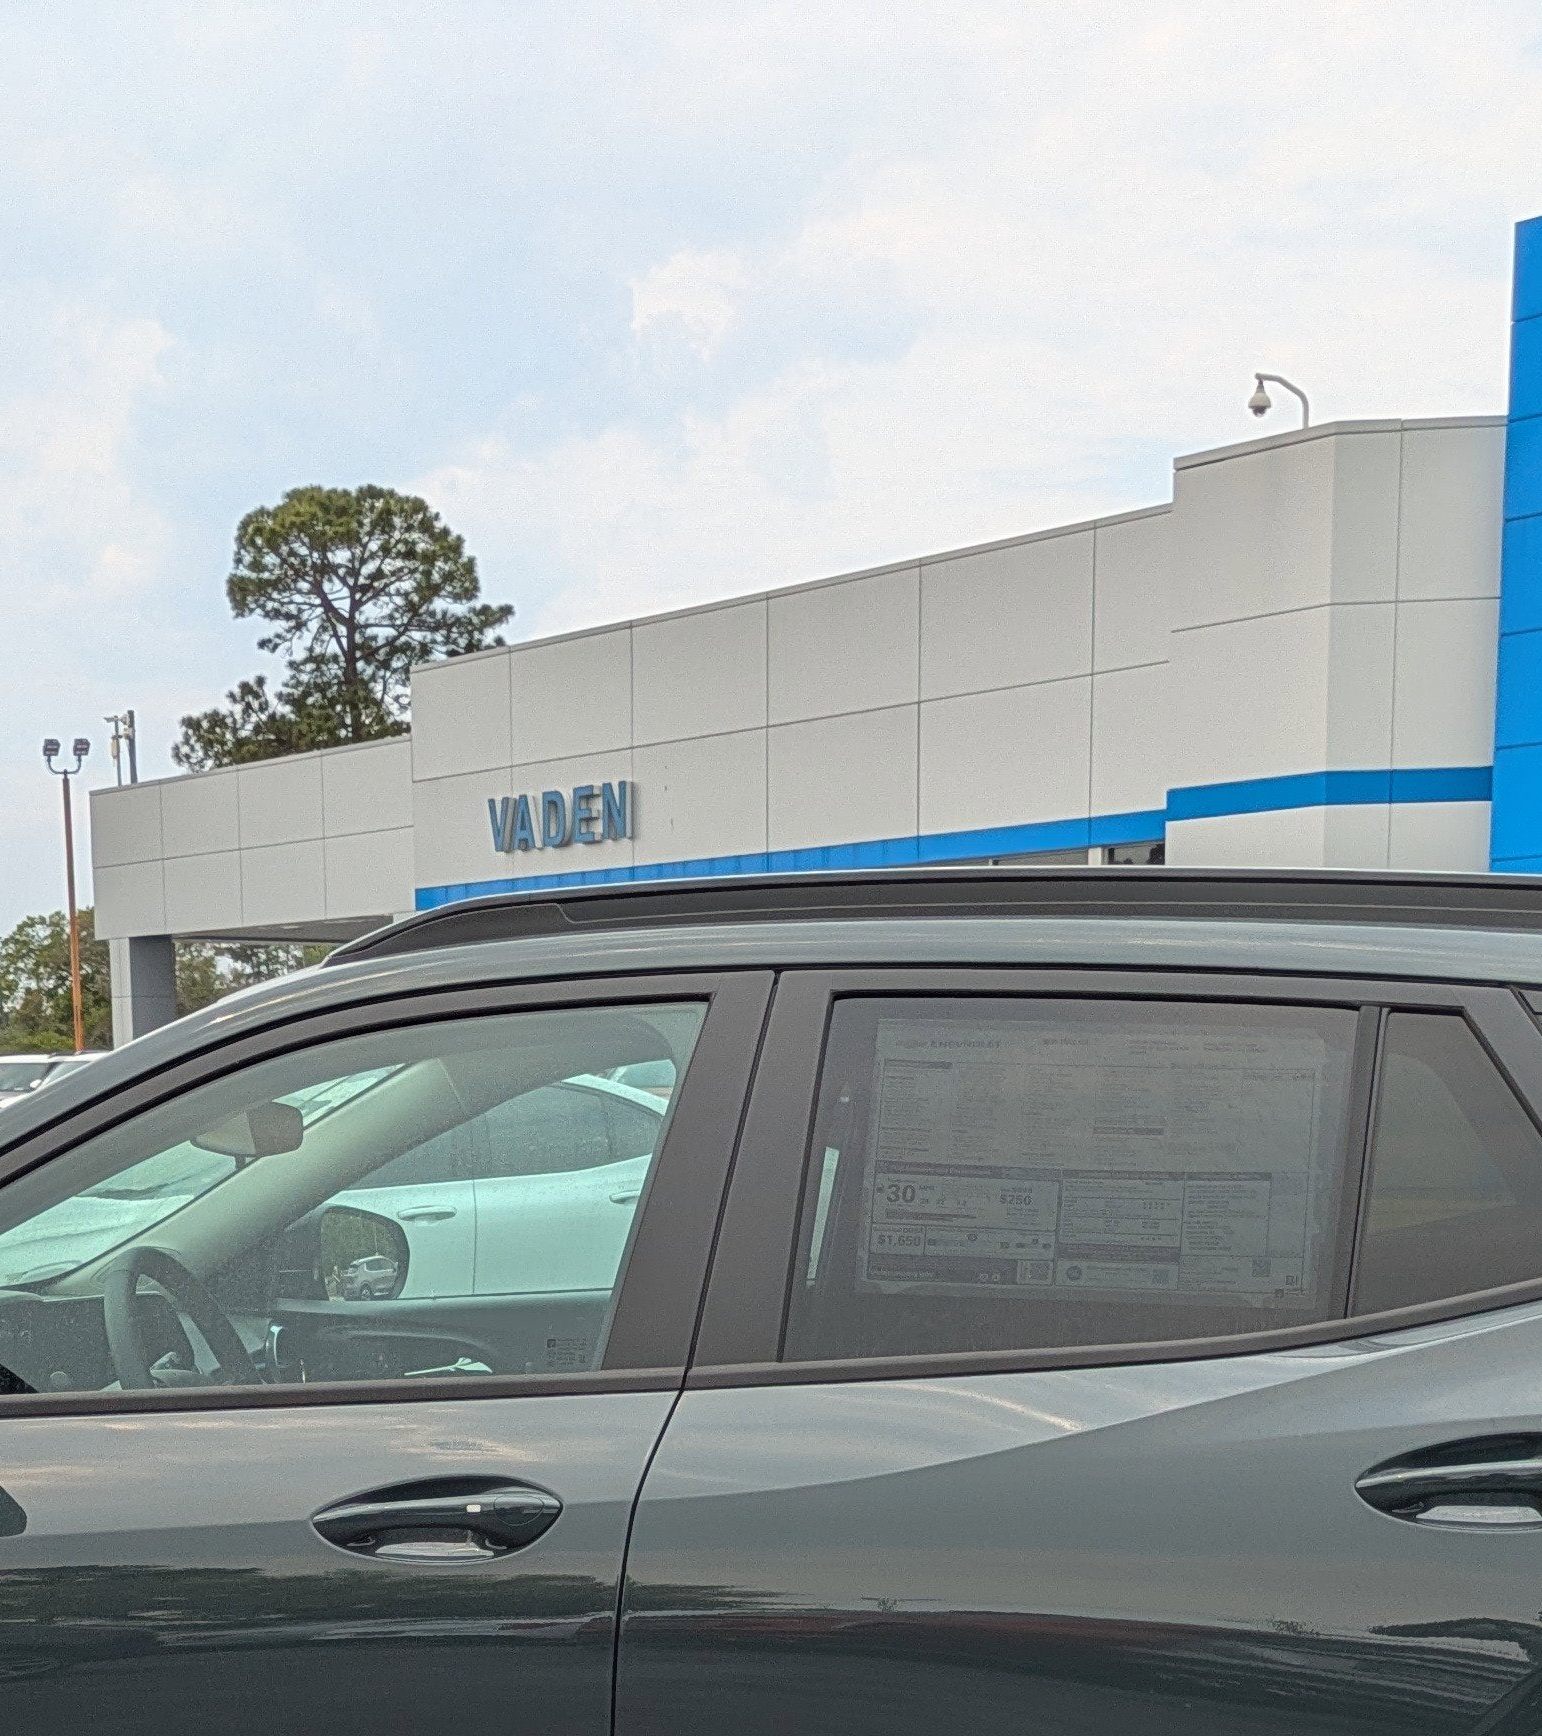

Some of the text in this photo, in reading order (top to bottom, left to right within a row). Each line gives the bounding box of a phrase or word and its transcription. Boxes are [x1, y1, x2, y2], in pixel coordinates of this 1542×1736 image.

[487, 780, 634, 853] VADEN
[886, 1184, 916, 1203] 30
[1000, 1194, 1032, 1206] $250
[877, 1234, 922, 1247] $1,650
